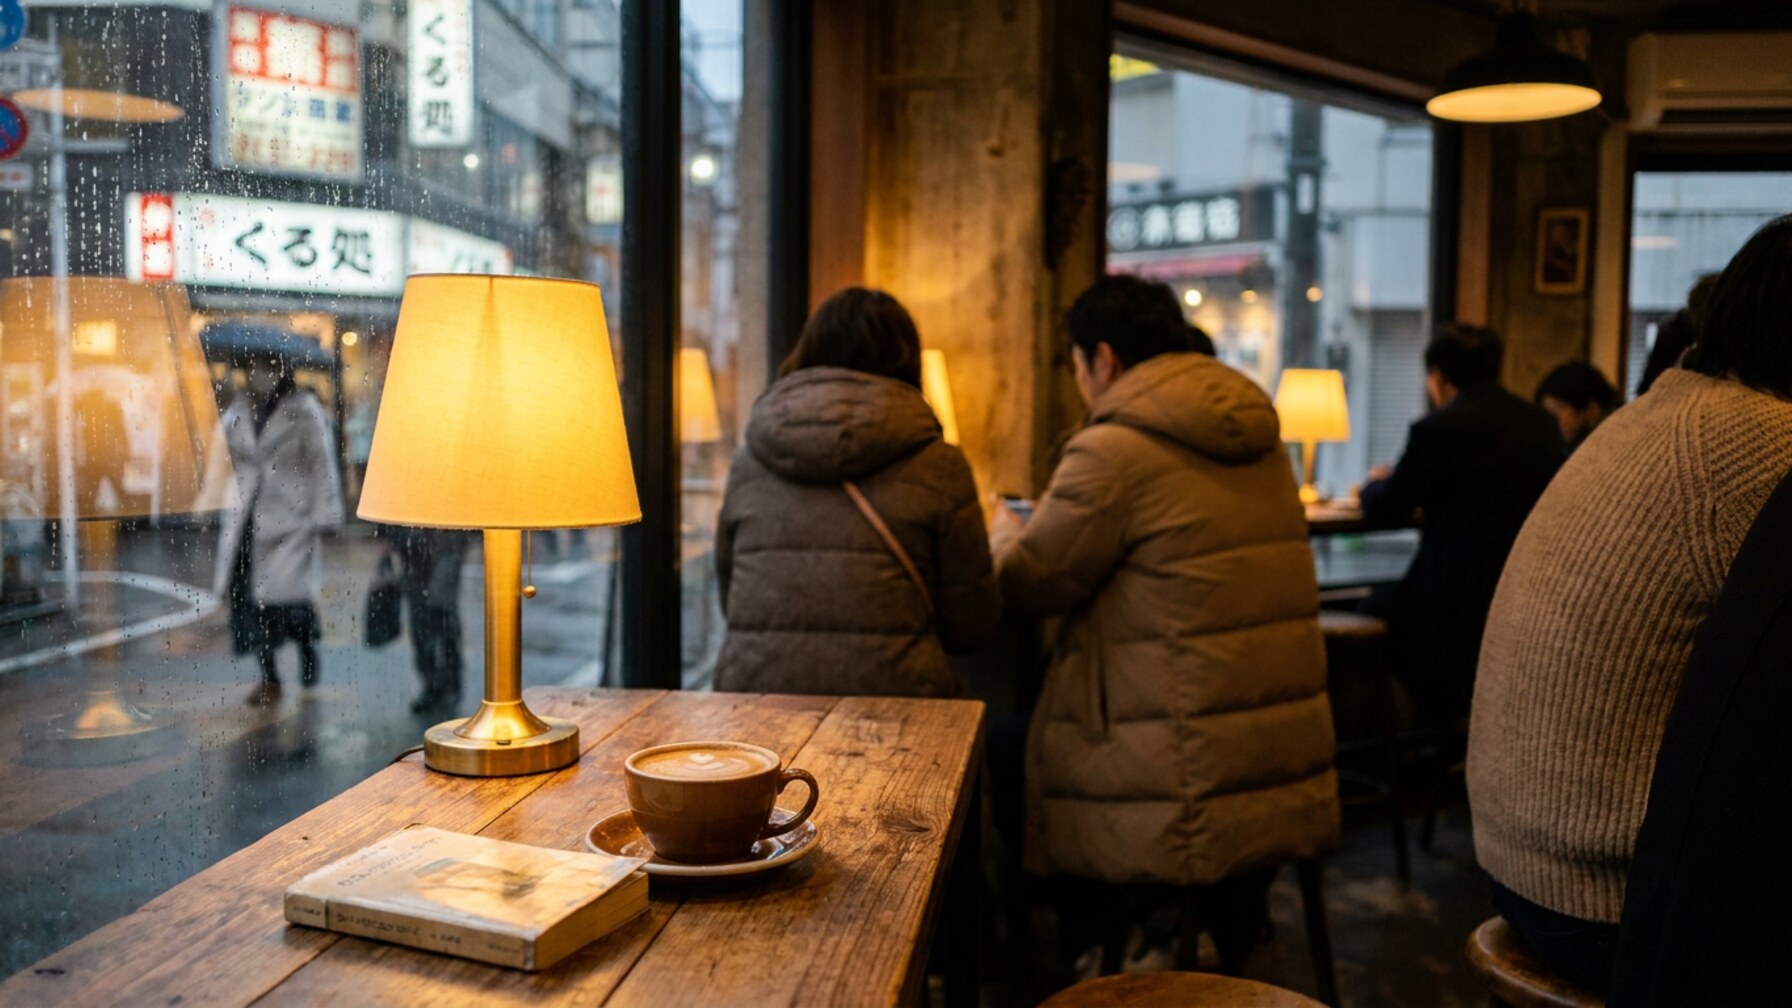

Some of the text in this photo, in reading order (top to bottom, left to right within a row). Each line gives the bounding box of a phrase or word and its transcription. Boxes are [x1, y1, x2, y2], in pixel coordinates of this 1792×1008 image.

[422, 13, 453, 136] くる処
[234, 221, 373, 275] くる処
